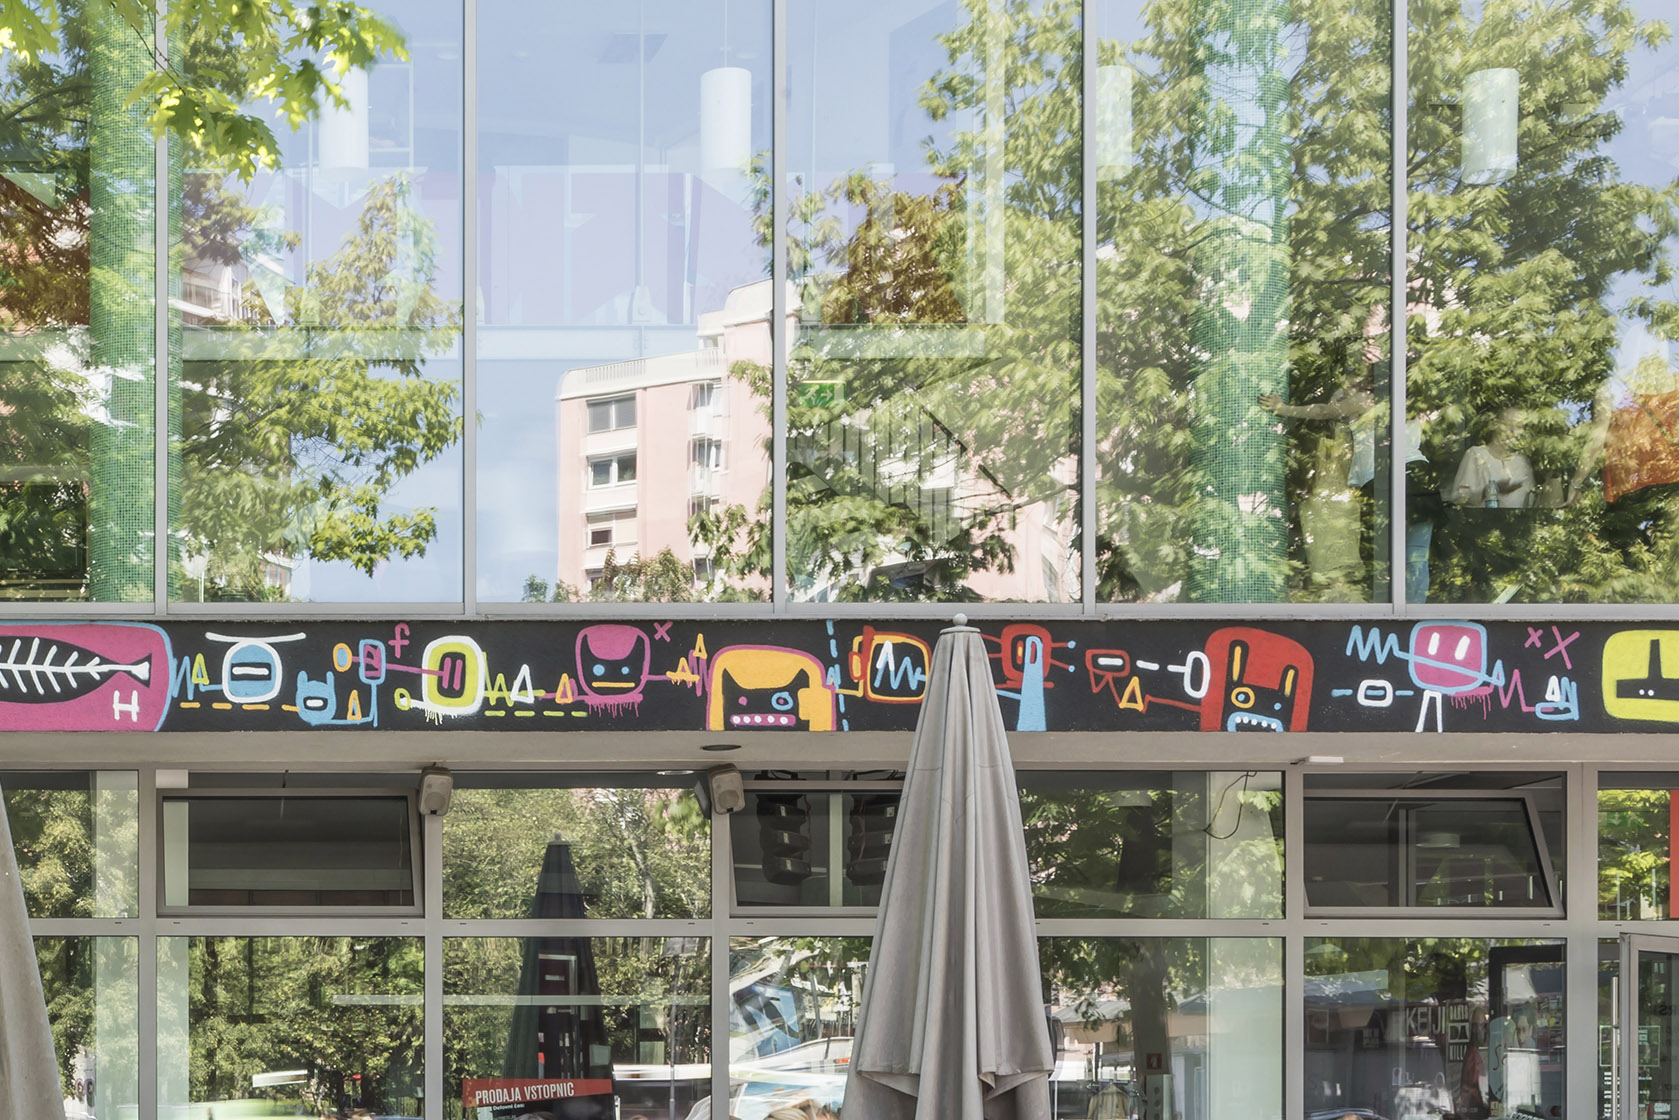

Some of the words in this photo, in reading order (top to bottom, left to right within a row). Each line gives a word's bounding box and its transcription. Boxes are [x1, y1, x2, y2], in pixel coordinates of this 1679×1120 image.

[1405, 1005, 1446, 1036] KEIJI
[475, 1086, 522, 1105] PRODAJA
[523, 1081, 575, 1101] VSTOPNIC
